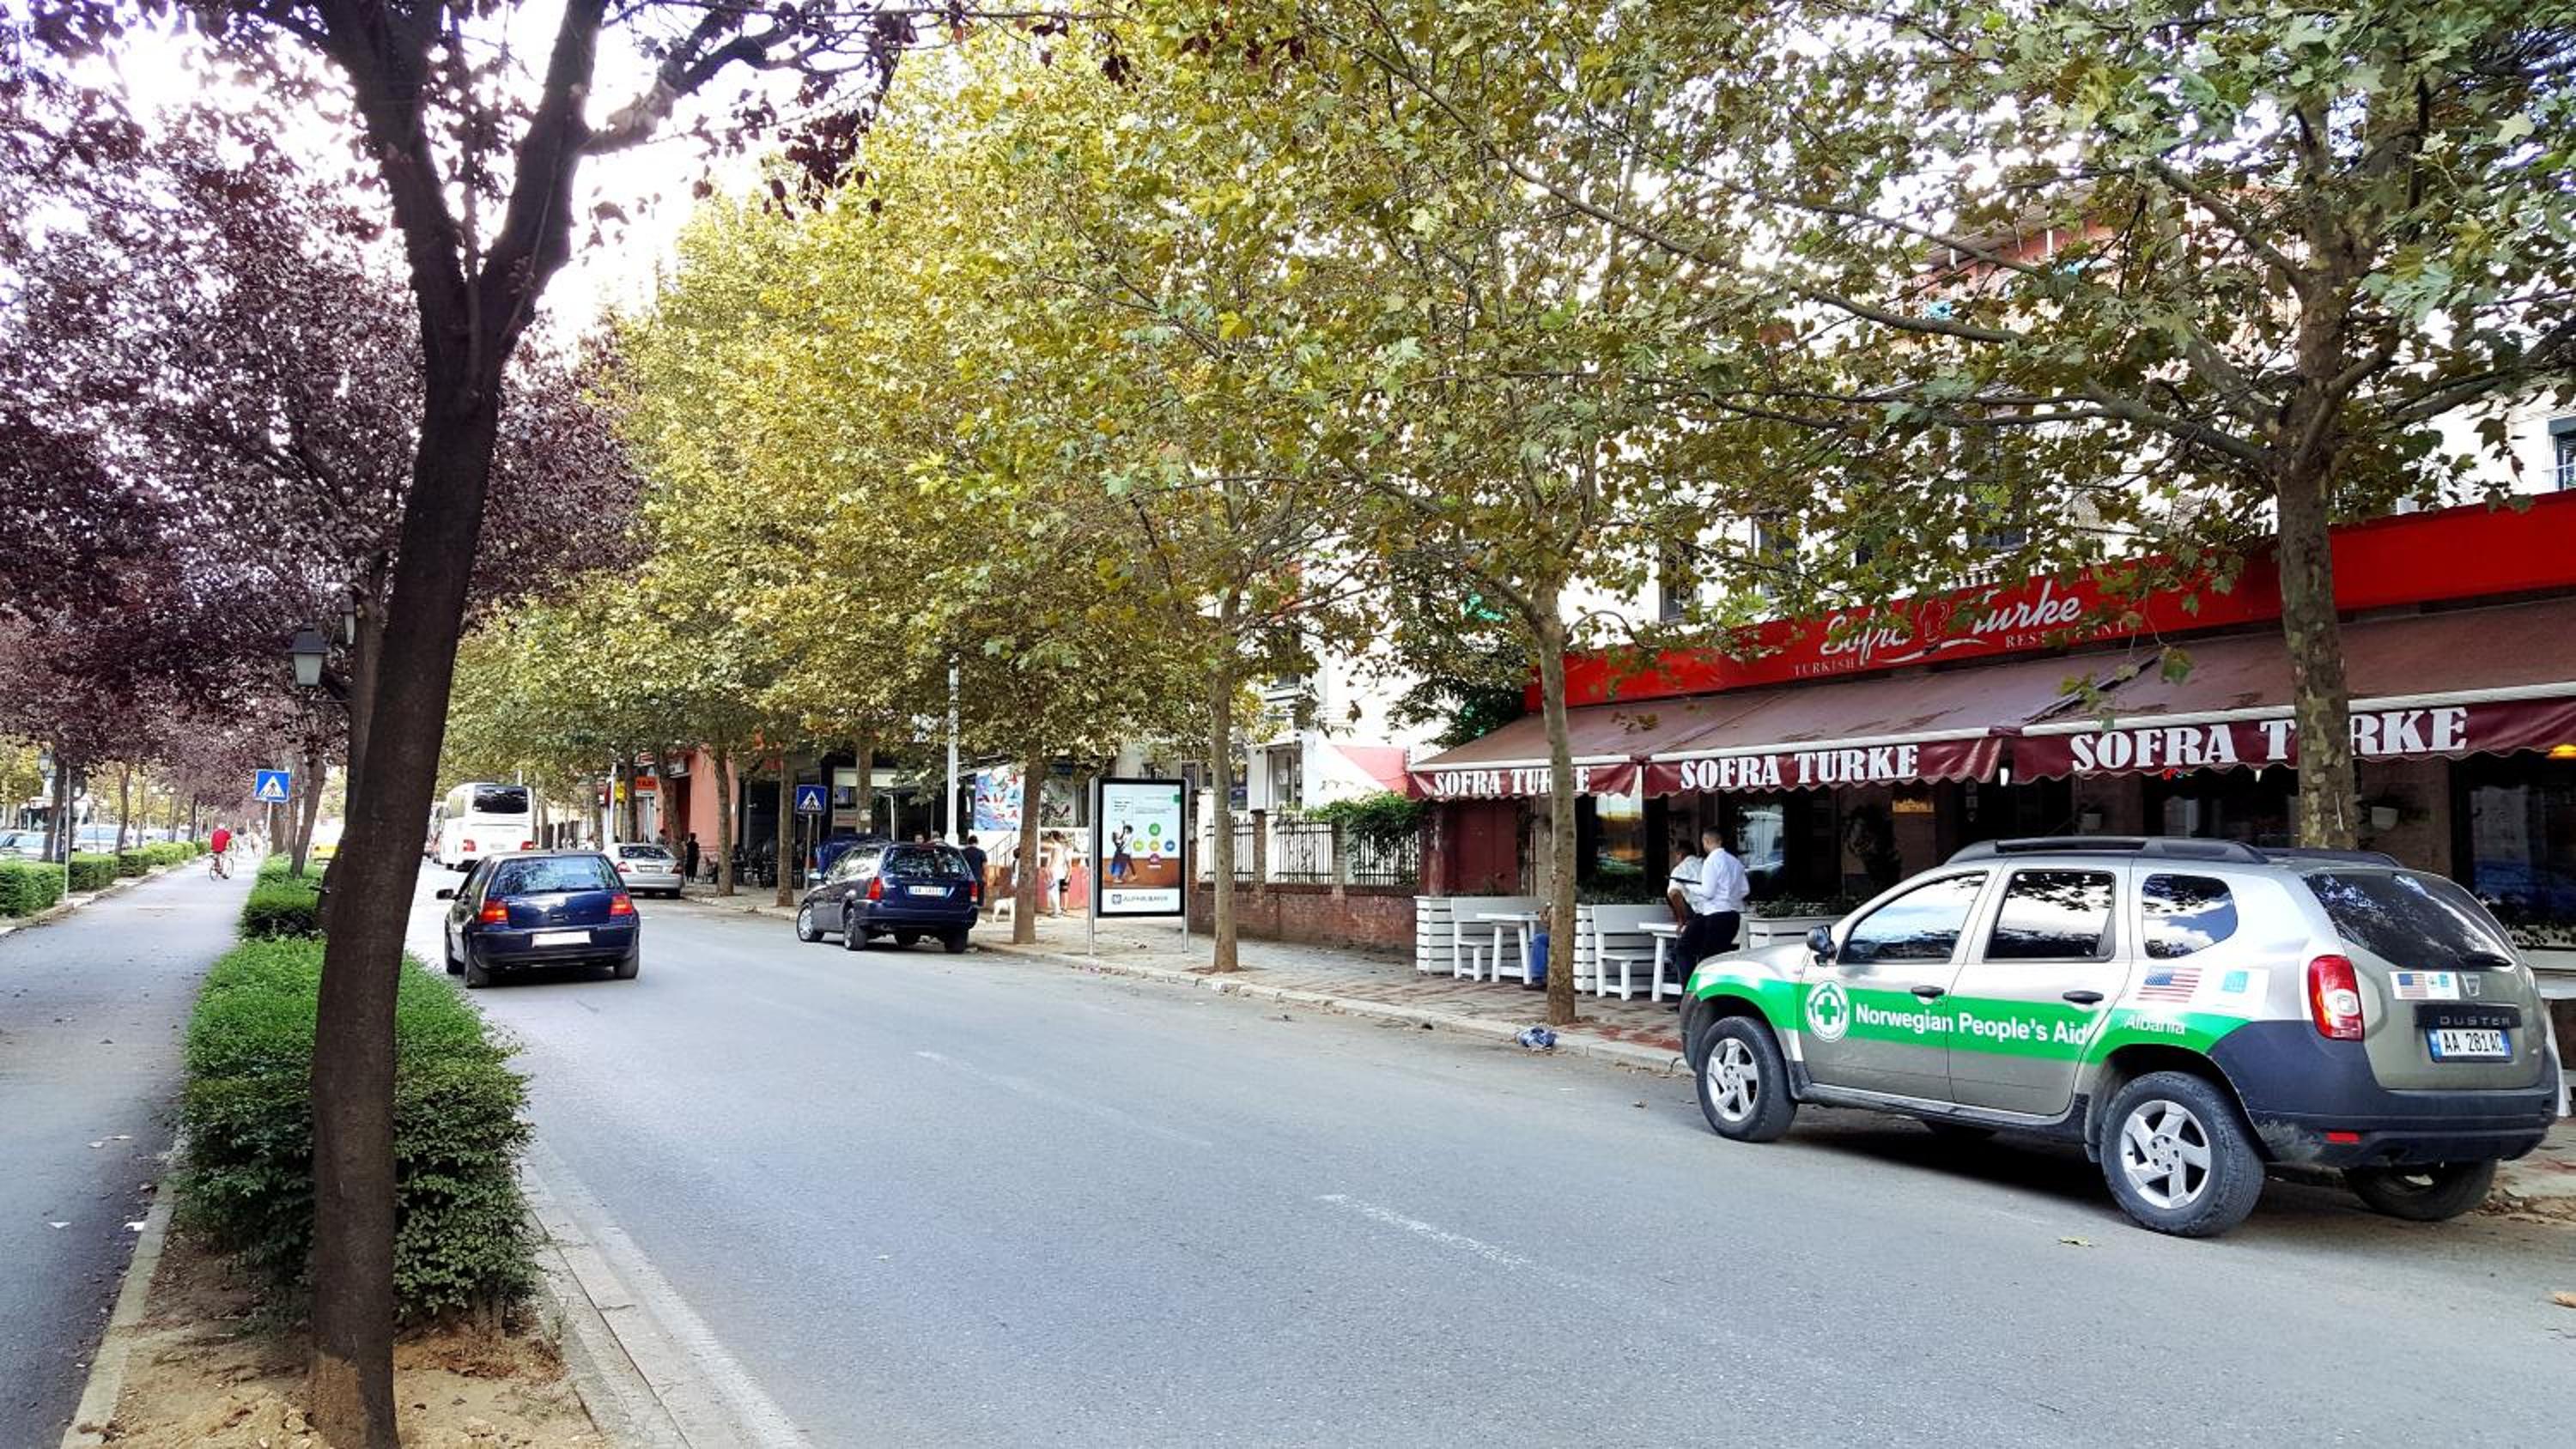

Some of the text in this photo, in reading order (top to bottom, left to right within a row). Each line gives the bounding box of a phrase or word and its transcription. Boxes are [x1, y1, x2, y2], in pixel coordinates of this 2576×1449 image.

[2070, 706, 2468, 771] SOFRA TRKE
[1433, 766, 1589, 796] SOFRA TURE
[1680, 744, 1917, 789] SOFRA TURKE
[1856, 1003, 1954, 1034] Norwegian
[1959, 1012, 2048, 1043] People's
[2053, 1020, 2088, 1045] Aid
[2124, 1014, 2185, 1035] Albania
[2439, 1016, 2511, 1027] DUSTER
[2443, 1031, 2462, 1053] AA
